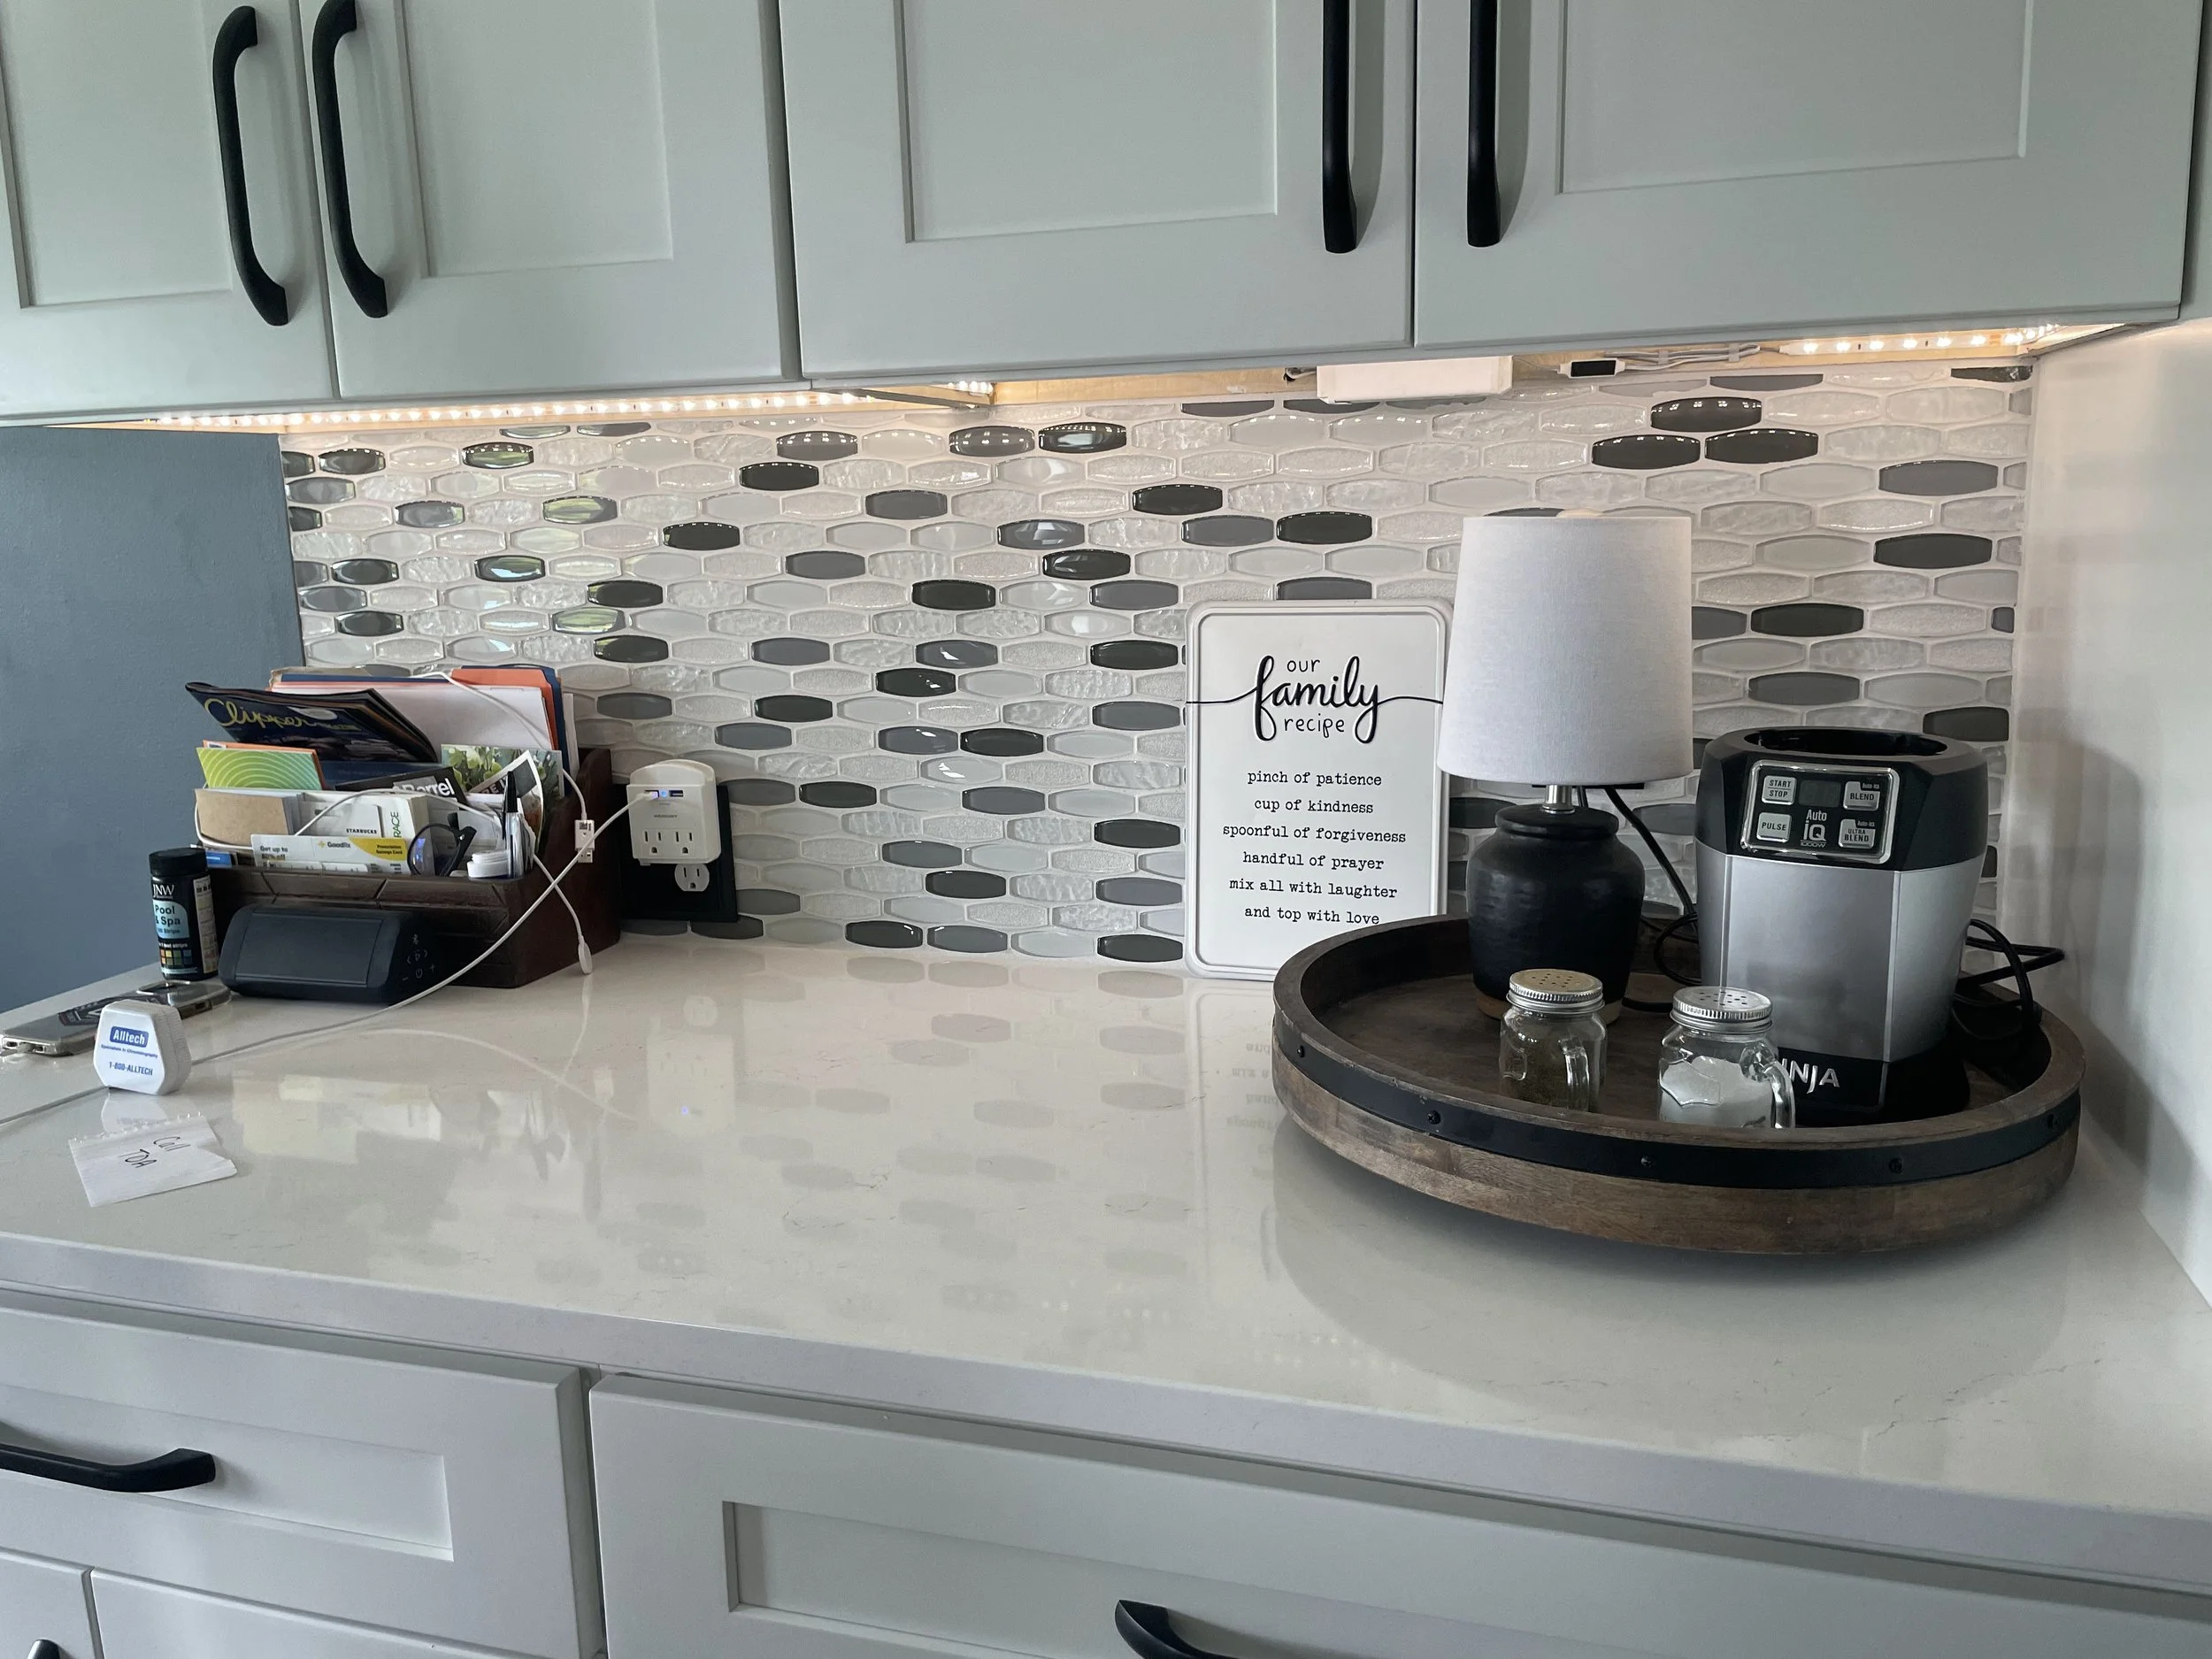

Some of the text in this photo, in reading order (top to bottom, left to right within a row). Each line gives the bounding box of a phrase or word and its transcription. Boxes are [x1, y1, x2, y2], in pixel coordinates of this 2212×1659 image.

[1286, 657, 1321, 673] our
[1252, 655, 1380, 744] family
[1283, 713, 1345, 739] recipe
[1247, 770, 1382, 787] pinch of patience
[1769, 780, 1792, 788] START
[1850, 792, 1875, 801] BLEND
[1254, 799, 1373, 814] cup of kindness
[1806, 809, 1827, 822] Auto
[1222, 824, 1406, 843] spoonful of forgiveness
[1761, 822, 1787, 831] PULSE
[1802, 820, 1827, 841] iQ
[1844, 833, 1870, 842] BLEND
[1242, 851, 1385, 872] handful of prayer
[1229, 877, 1398, 899] mix all with laughter
[155, 904, 175, 915] Pool
[1244, 906, 1379, 925] and top with love
[161, 916, 181, 928] Spa
[112, 1029, 146, 1045] Alltech
[109, 1061, 154, 1076] 1-800-ALLTECH
[1779, 1057, 1840, 1094] INJA
